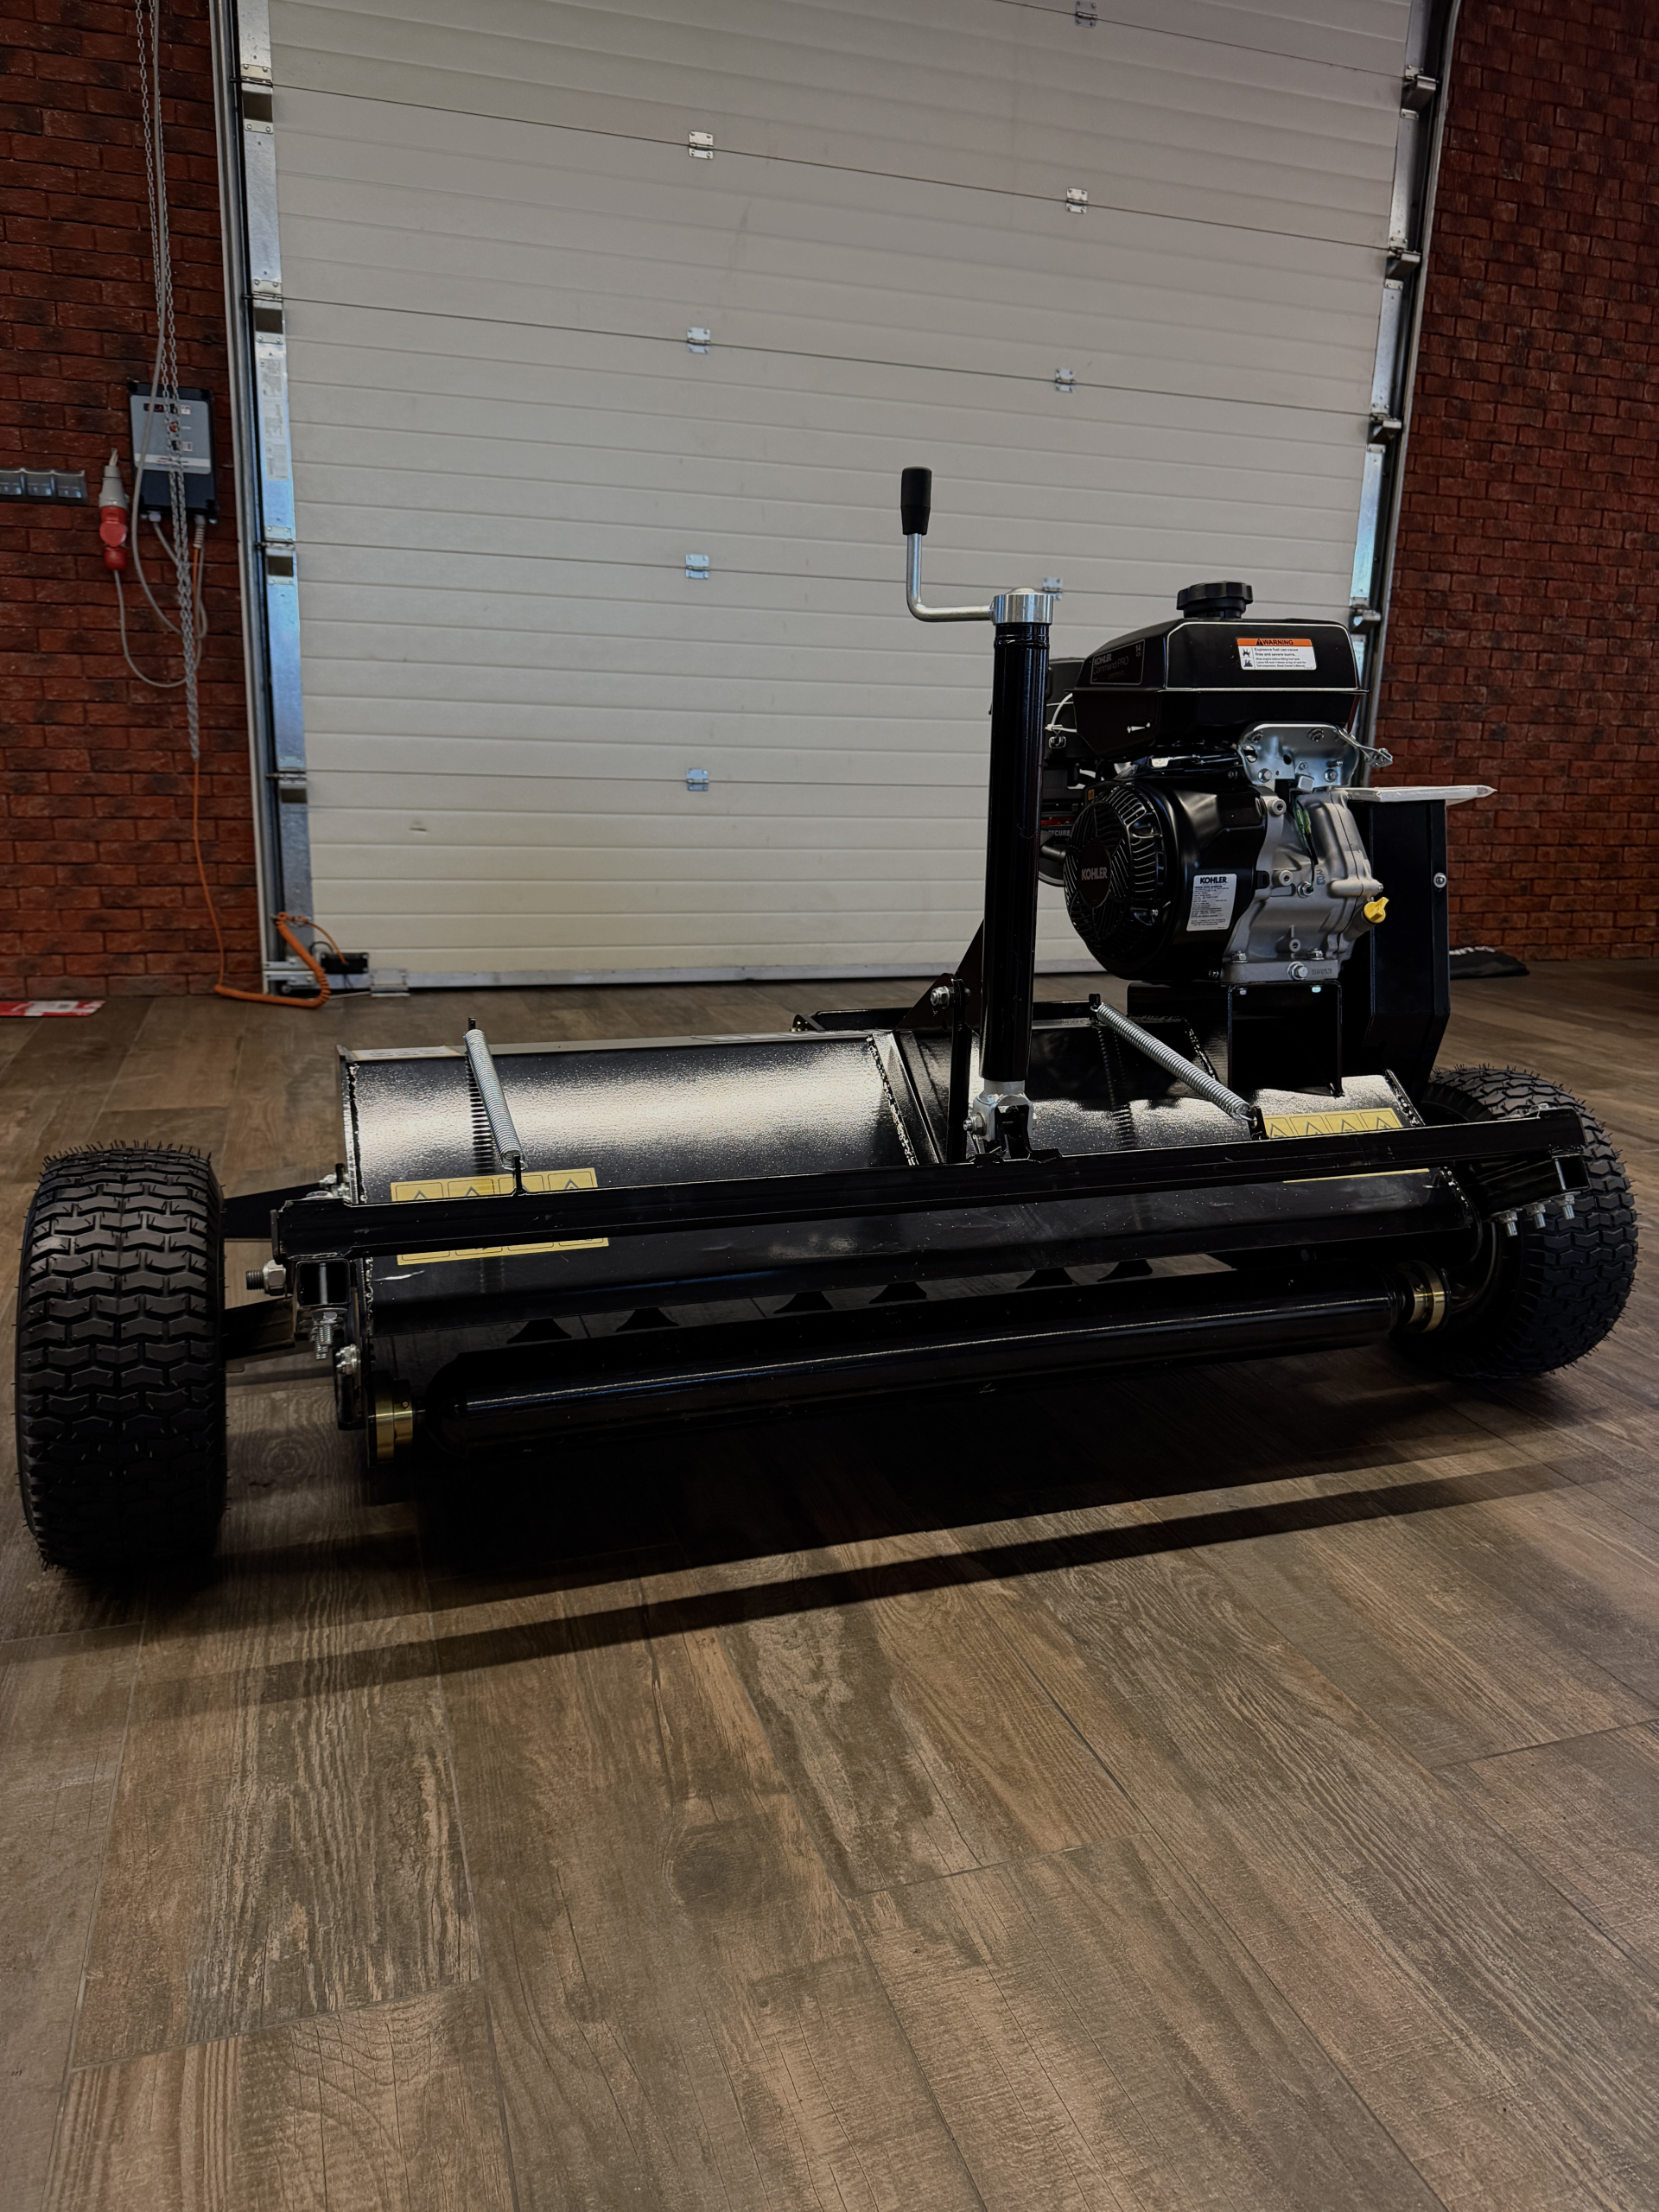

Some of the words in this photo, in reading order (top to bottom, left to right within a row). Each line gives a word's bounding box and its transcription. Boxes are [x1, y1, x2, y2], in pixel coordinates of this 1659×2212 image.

[1094, 652, 1112, 666] KOHLER
[1117, 656, 1129, 667] PRO
[1081, 867, 1108, 880] KOHLER
